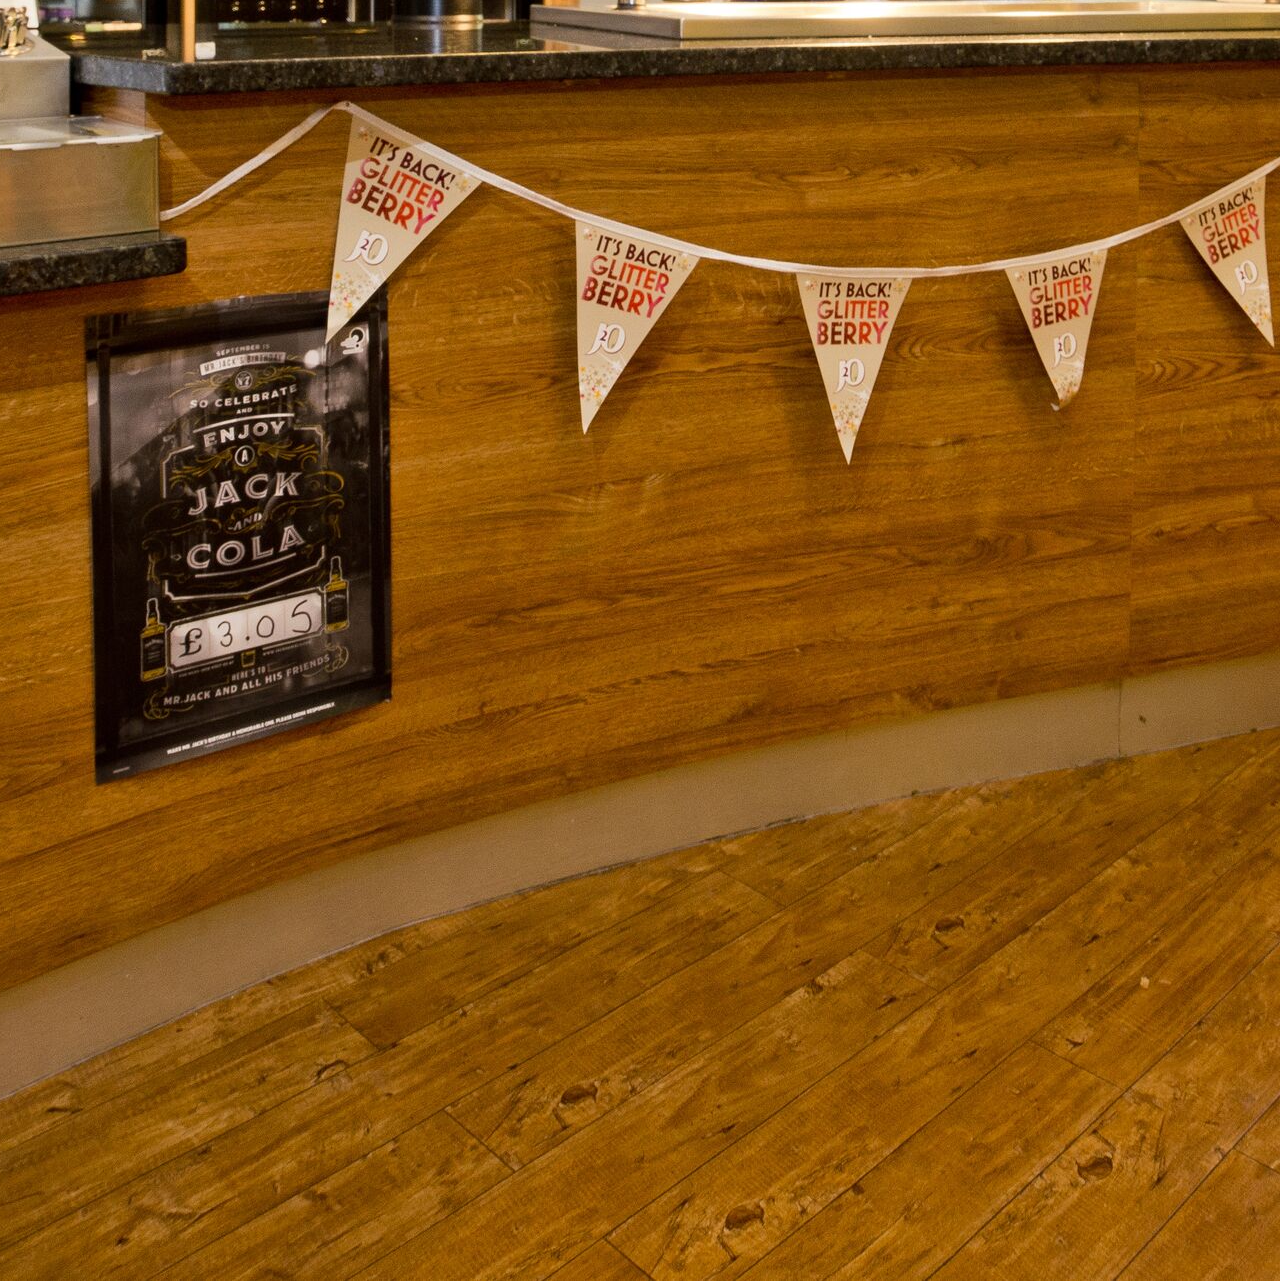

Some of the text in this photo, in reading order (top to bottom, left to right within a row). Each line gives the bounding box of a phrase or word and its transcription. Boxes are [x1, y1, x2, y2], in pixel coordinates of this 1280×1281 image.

[370, 137, 455, 190] IT'S BACK!
[360, 157, 444, 212] GLITTER
[346, 178, 436, 235] BERRY
[1199, 187, 1254, 226] IT'S BACK!
[1202, 203, 1257, 243] GLITTER
[596, 235, 676, 271] IT'S BACK!
[1207, 219, 1260, 264] BERRY
[590, 255, 669, 294] GLITTER
[819, 282, 892, 297] IT'S BACK!
[1028, 258, 1091, 286] IT'S BACK!
[1030, 275, 1092, 305] GLITTER
[582, 276, 664, 318] BERRY
[817, 300, 889, 319] GLITTER
[1032, 294, 1092, 329] BERRY
[216, 344, 260, 356] SEPTEMBER
[817, 322, 888, 345] BERRY
[246, 354, 282, 364] BIRTHDAY
[189, 383, 298, 409] SO CELEBRATE
[236, 407, 253, 415] AND
[203, 421, 285, 448] ENJOY
[188, 472, 303, 515] JACK
[186, 524, 305, 569] COLA
[179, 599, 312, 658] £3.05
[215, 683, 237, 697] AND
[242, 678, 261, 691] ALL
[265, 673, 282, 684] HIS
[287, 654, 330, 677] FRIENDS
